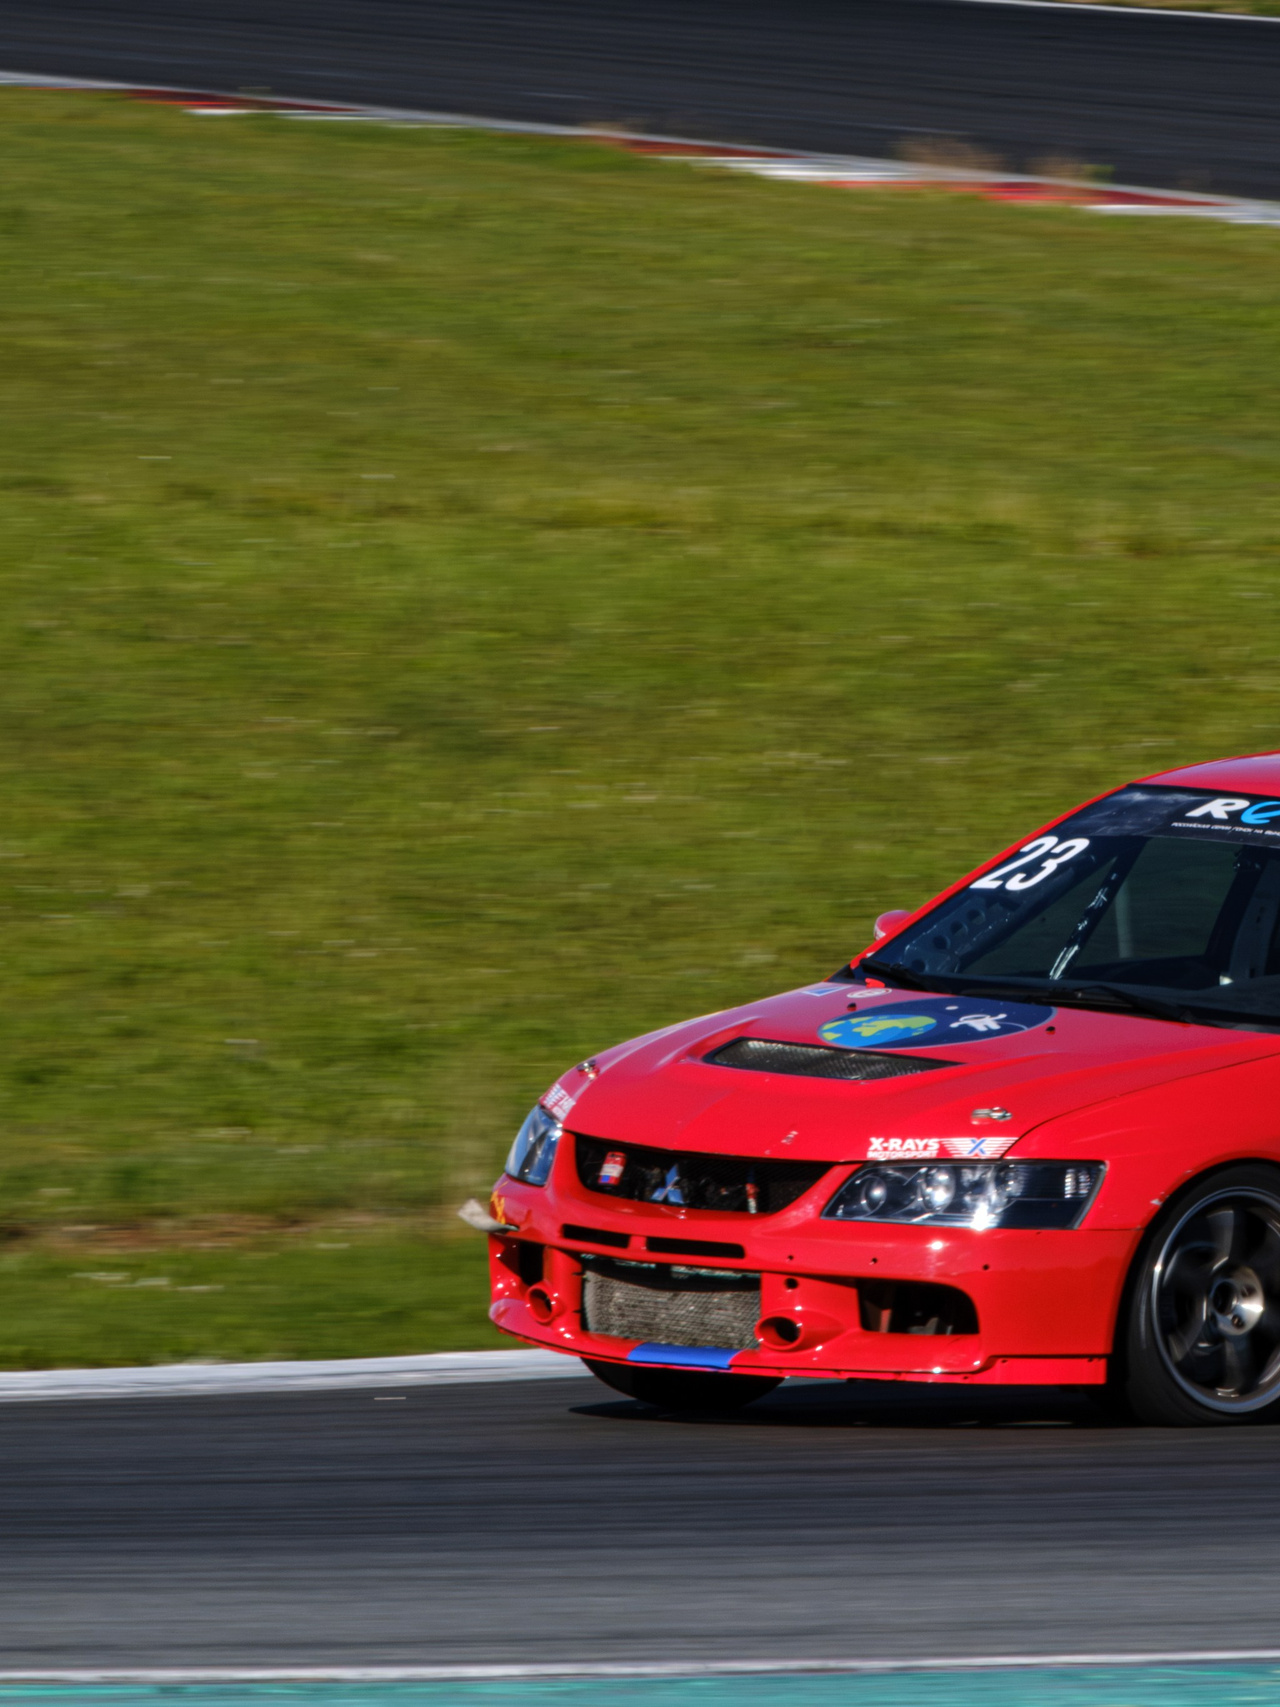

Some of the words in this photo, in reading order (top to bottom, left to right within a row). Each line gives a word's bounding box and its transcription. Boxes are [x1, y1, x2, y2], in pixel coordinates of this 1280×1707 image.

[969, 836, 1090, 891] 23
[868, 1137, 940, 1151] X-RAYS
[867, 1151, 939, 1159] MOTORSPORT
